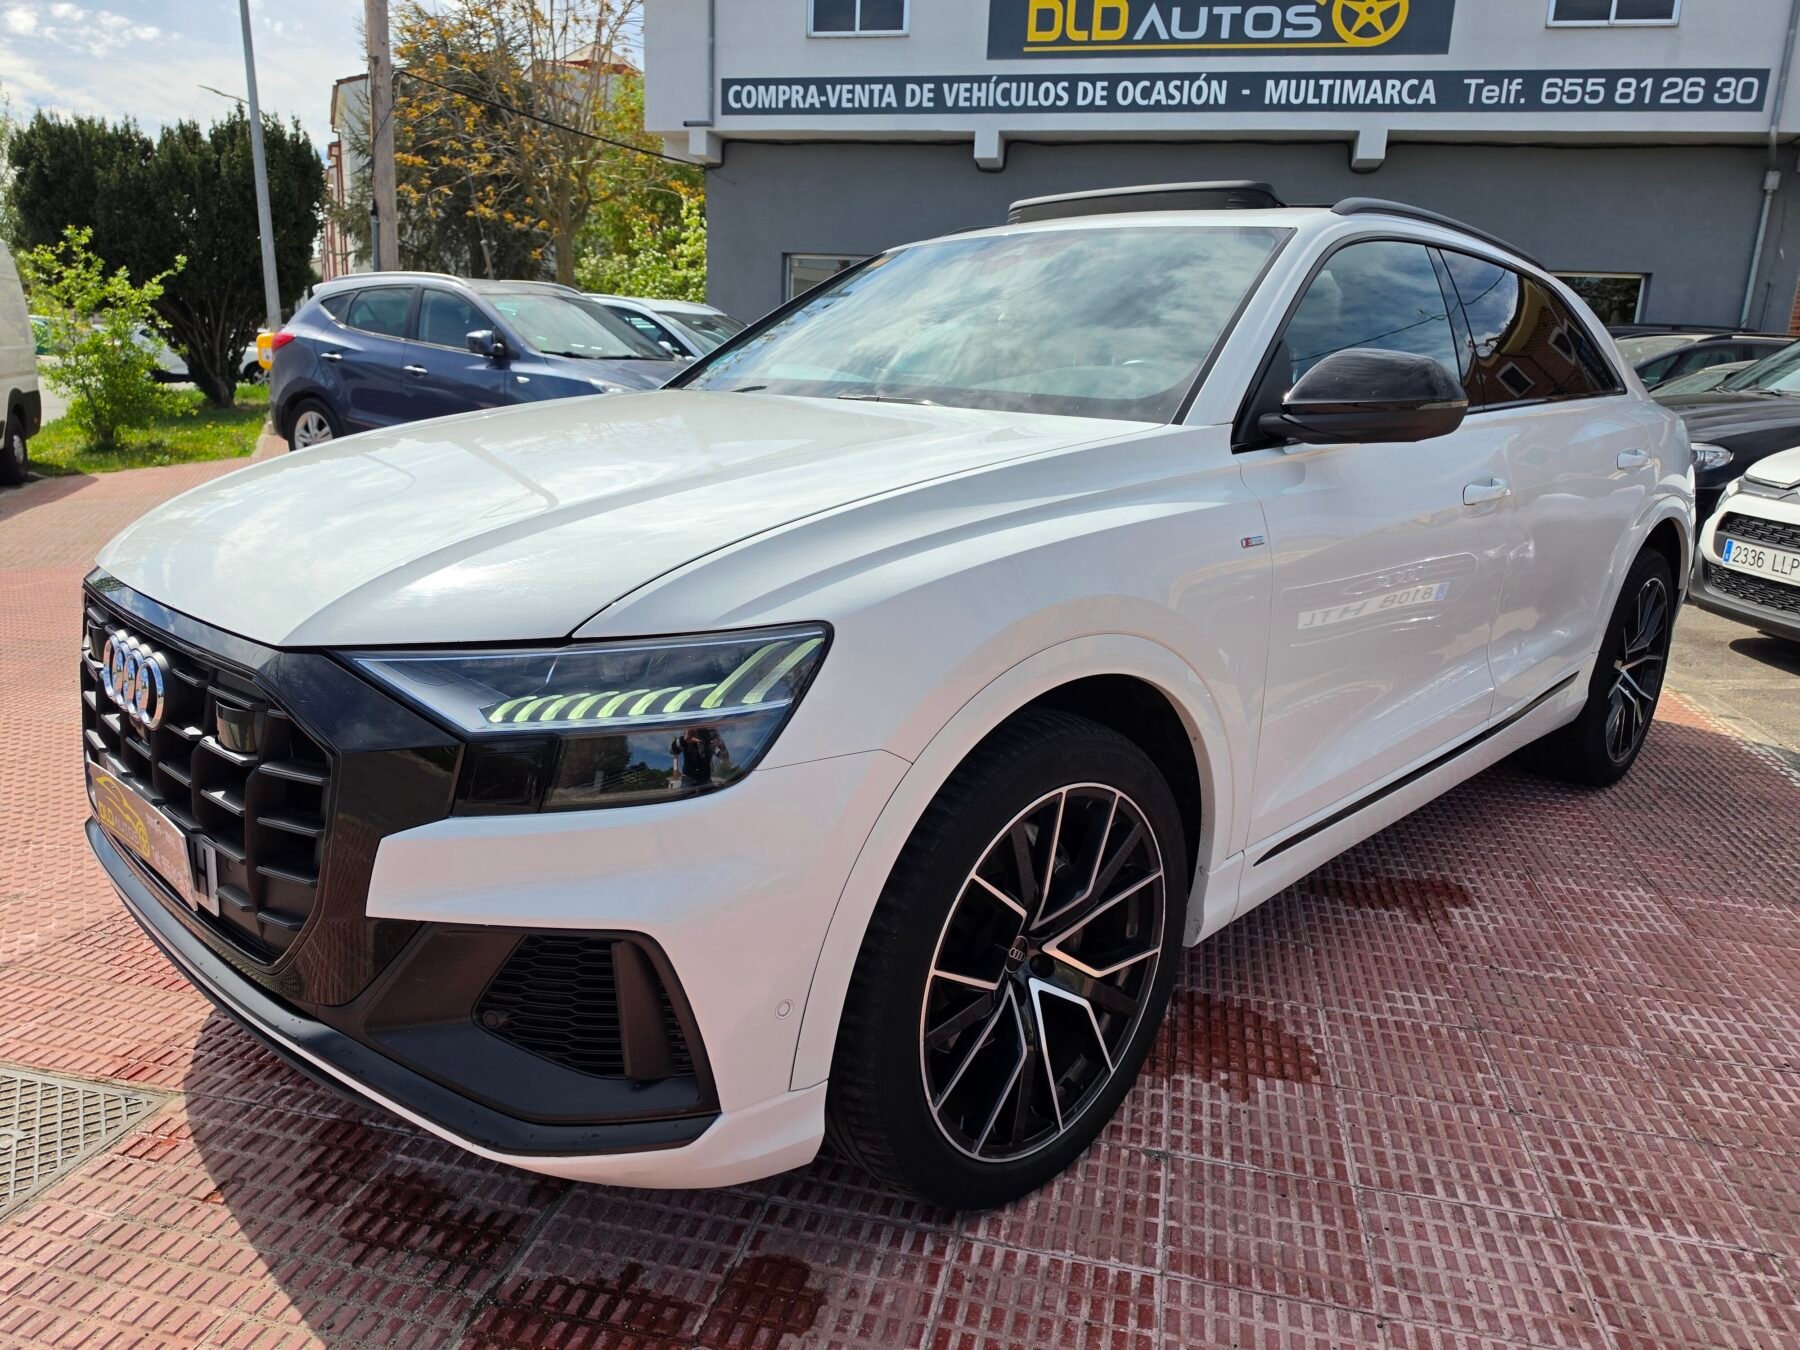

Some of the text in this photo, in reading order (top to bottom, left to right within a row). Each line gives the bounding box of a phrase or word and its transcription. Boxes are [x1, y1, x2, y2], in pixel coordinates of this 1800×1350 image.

[1027, 0, 1322, 42] DLD AUTOS
[727, 82, 898, 109] COMPRA-VENTA
[905, 82, 935, 108] DE
[943, 75, 1069, 108] VEHÍCULOS
[1077, 80, 1108, 106] DE
[1116, 73, 1228, 106] OCASIÓN
[1264, 79, 1437, 105] MULTIMARCA
[1463, 78, 1526, 104] Telf.
[1541, 77, 1606, 104] 655
[1712, 76, 1760, 104] 30
[1732, 545, 1800, 576] 2336 LLP
